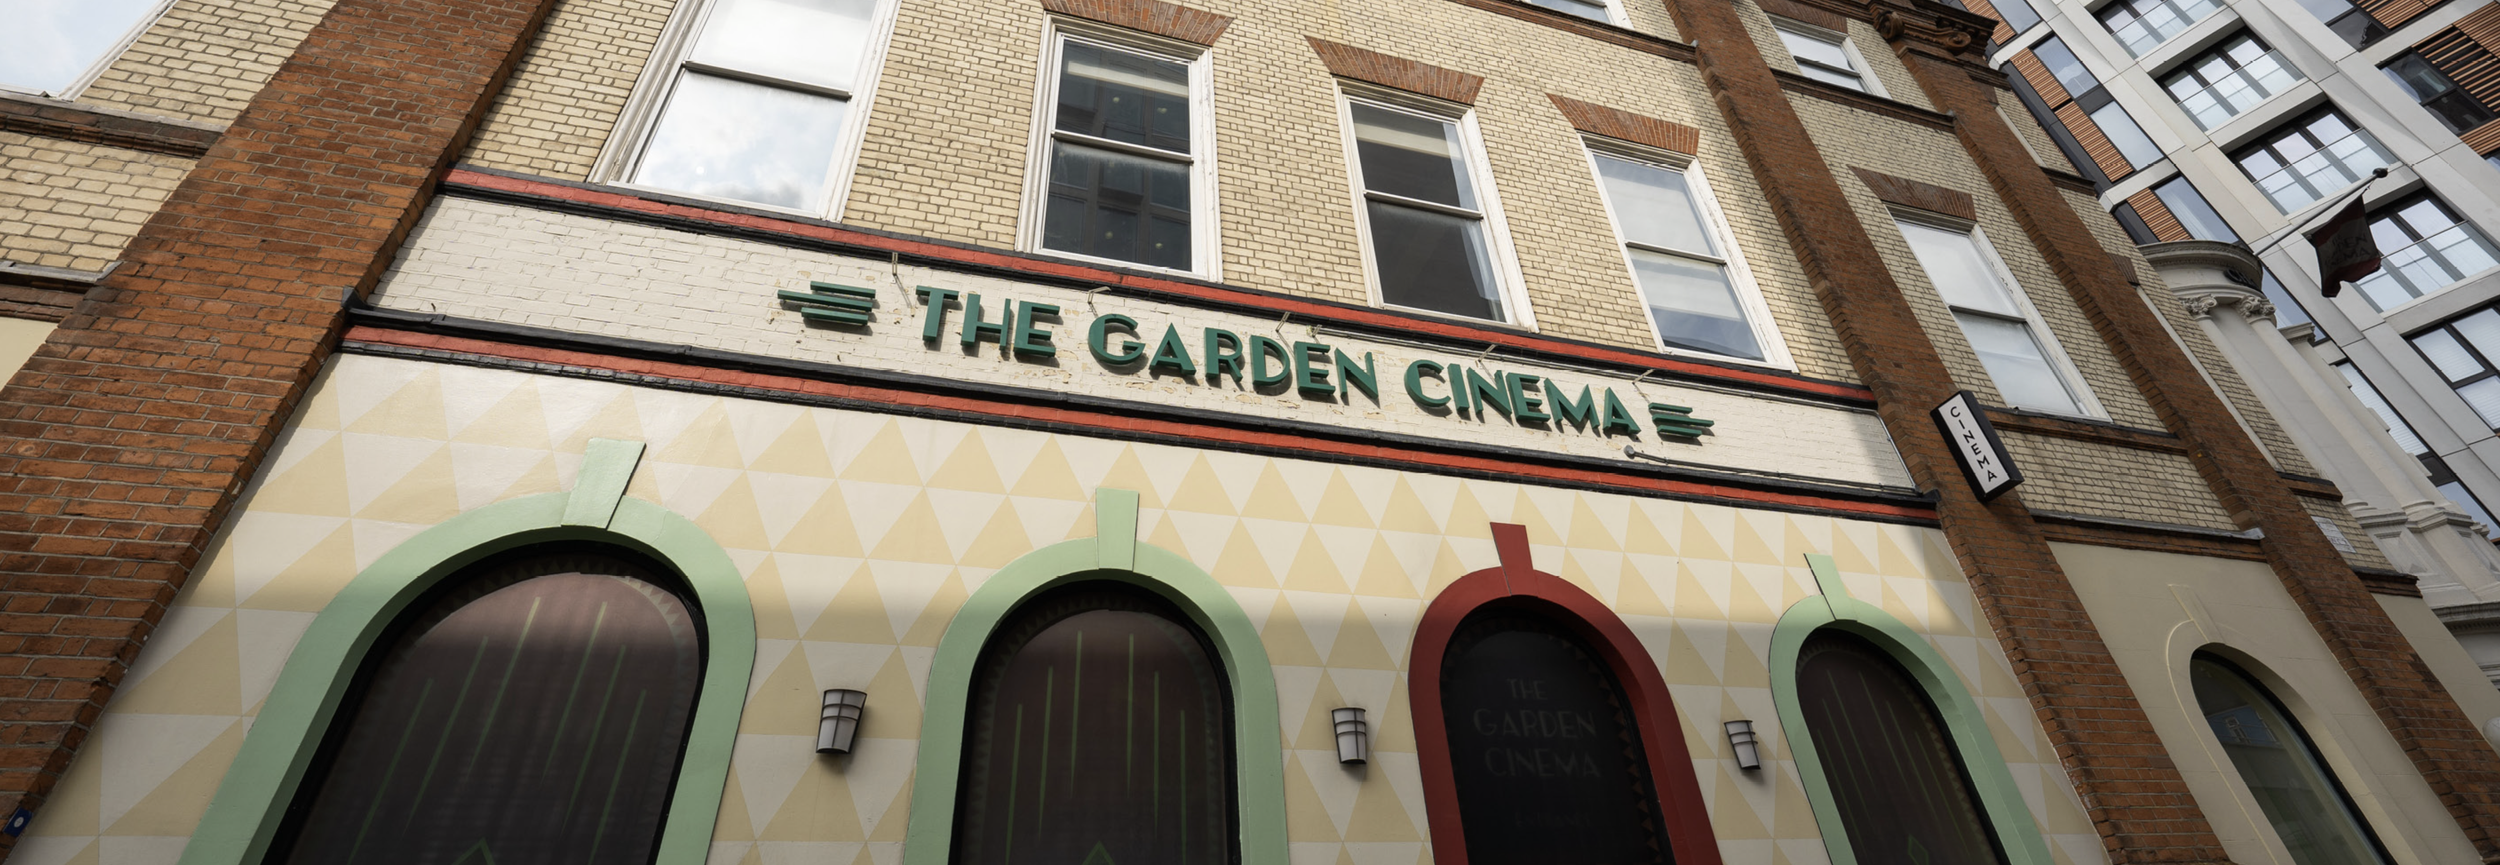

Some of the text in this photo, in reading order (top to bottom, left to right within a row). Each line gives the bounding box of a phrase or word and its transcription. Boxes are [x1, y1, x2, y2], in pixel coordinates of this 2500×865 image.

[915, 285, 1641, 435] THE GARDEN CINEMA
[1950, 406, 1997, 483] CINEMA
[1507, 679, 1548, 700] THE
[1474, 709, 1597, 738] GARDEN
[1486, 748, 1601, 777] CINEMA
